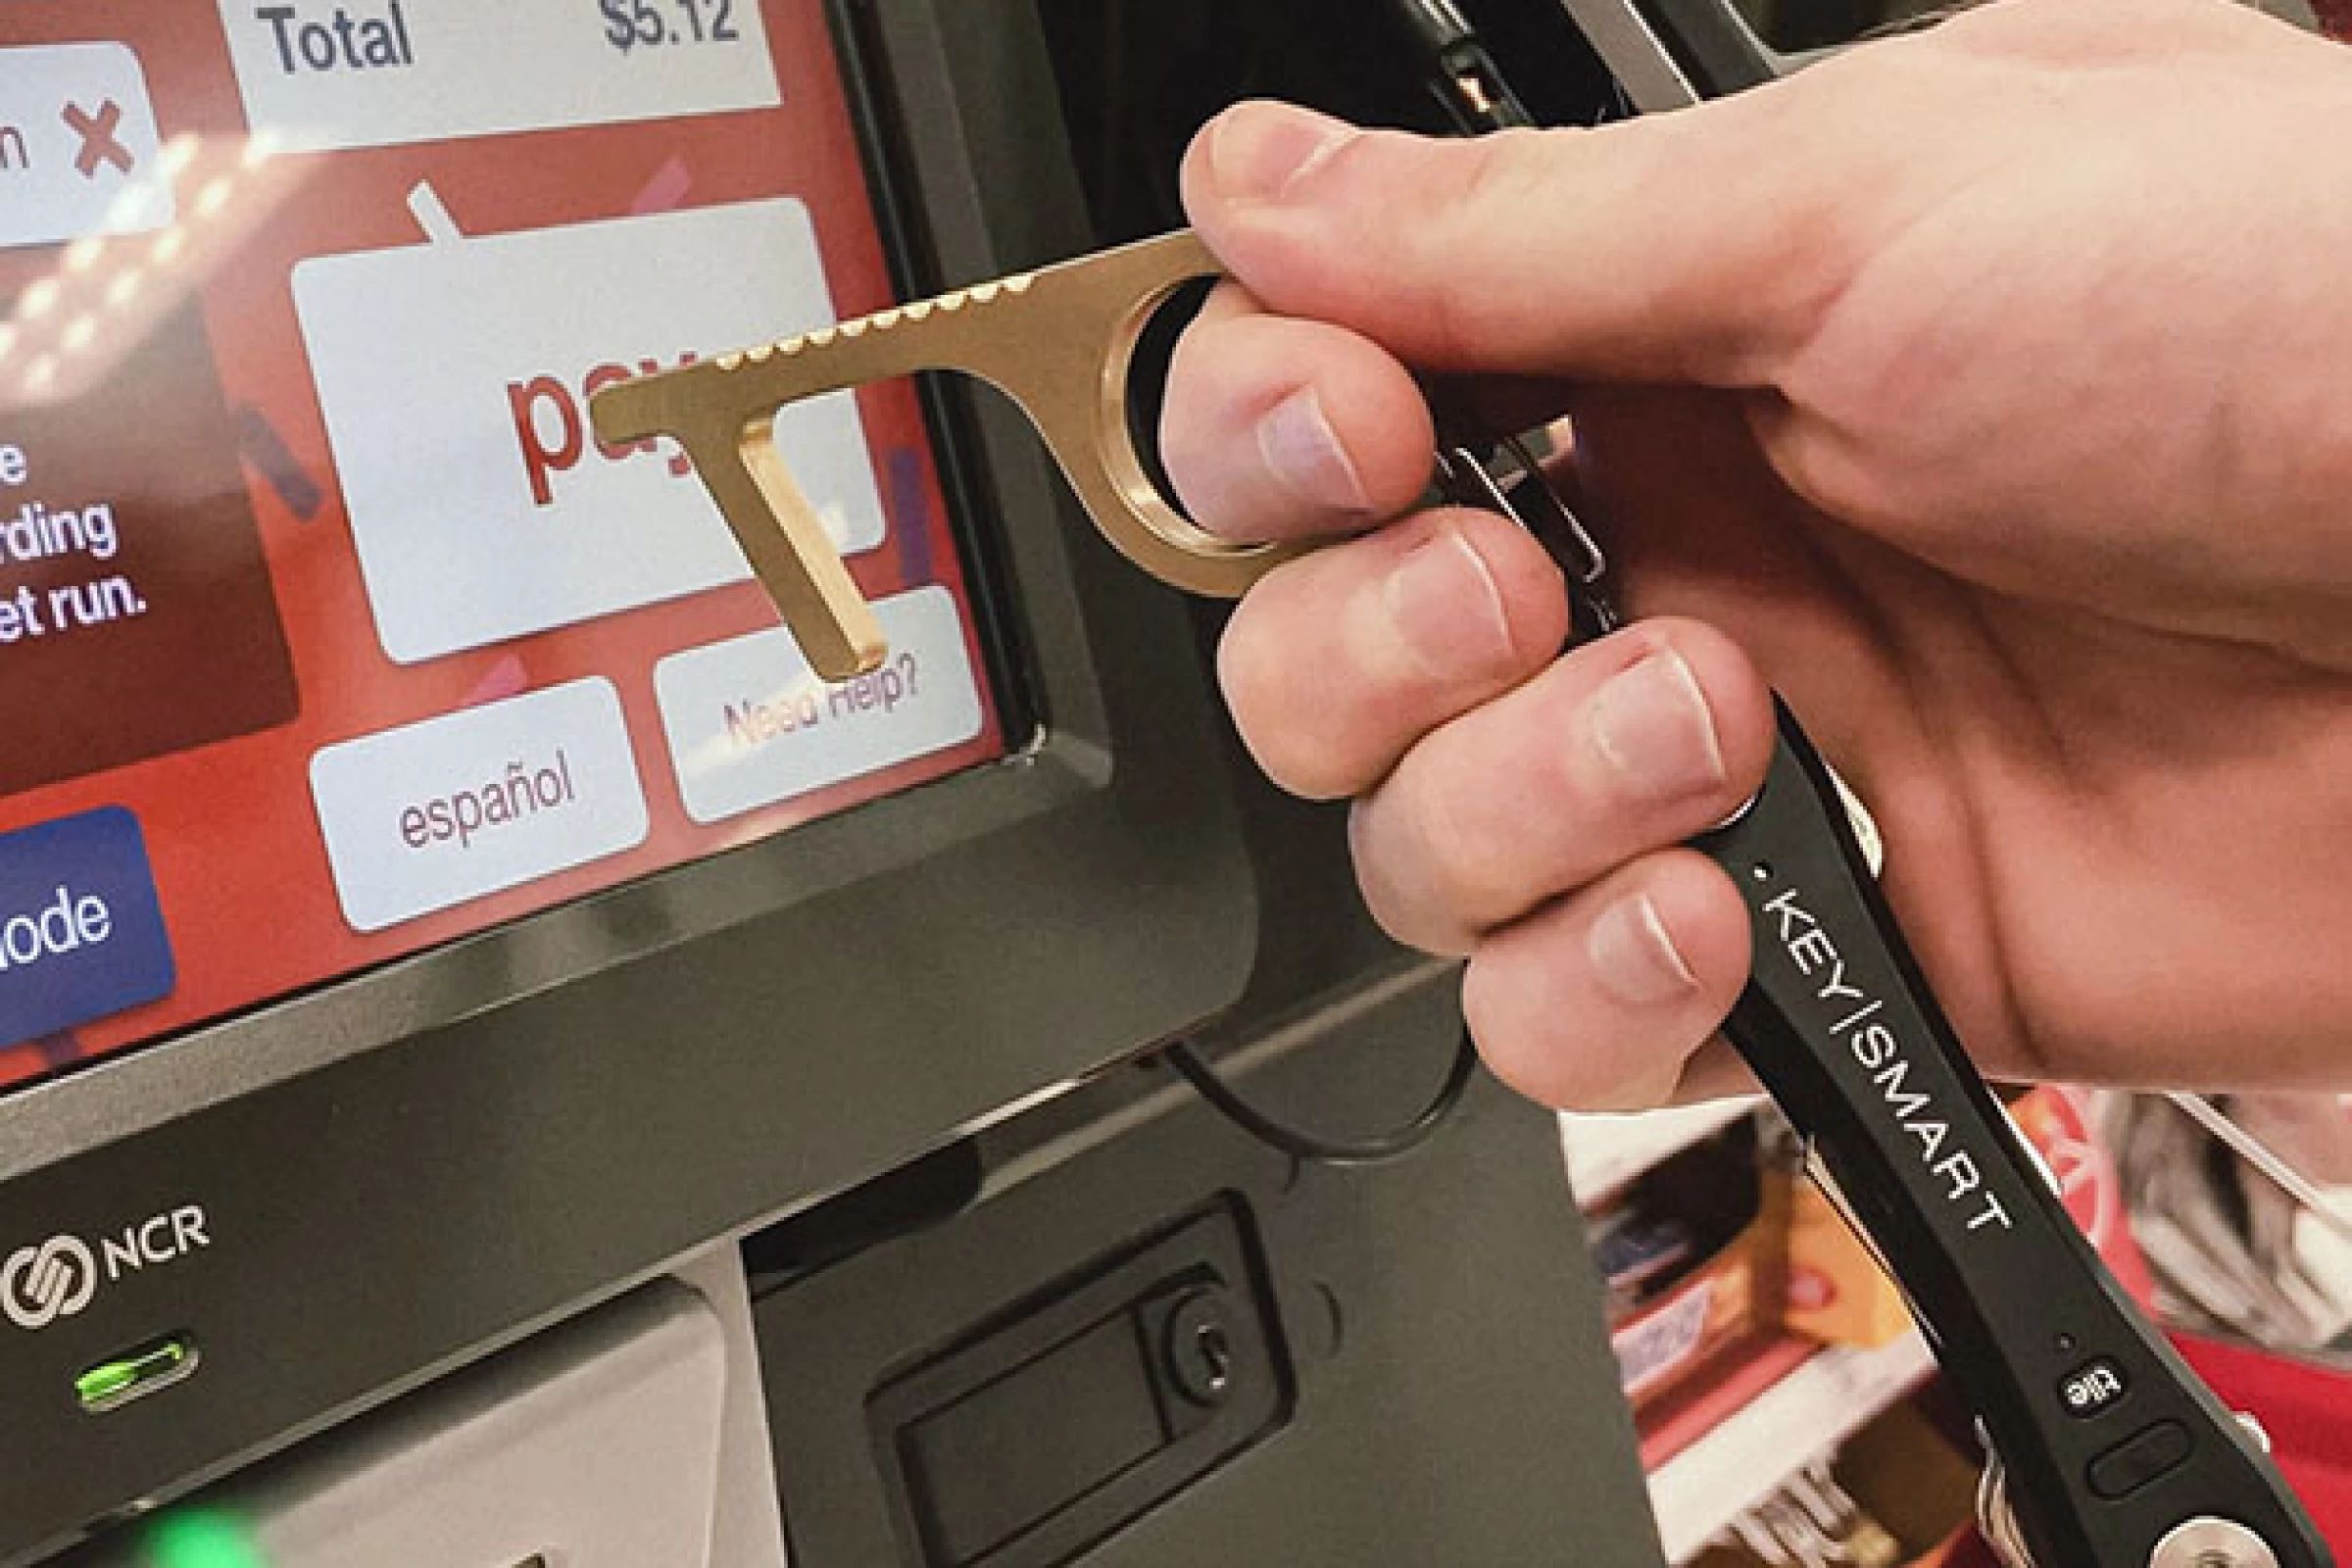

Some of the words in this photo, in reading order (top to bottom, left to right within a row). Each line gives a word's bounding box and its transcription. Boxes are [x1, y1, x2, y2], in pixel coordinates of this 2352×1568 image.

[255, 7, 414, 74] Total
[598, 0, 740, 55] $5.12
[49, 575, 147, 630] run.
[829, 652, 917, 717] Help?
[400, 749, 575, 849] español
[0, 885, 112, 970] ode
[100, 1204, 211, 1281] NCR
